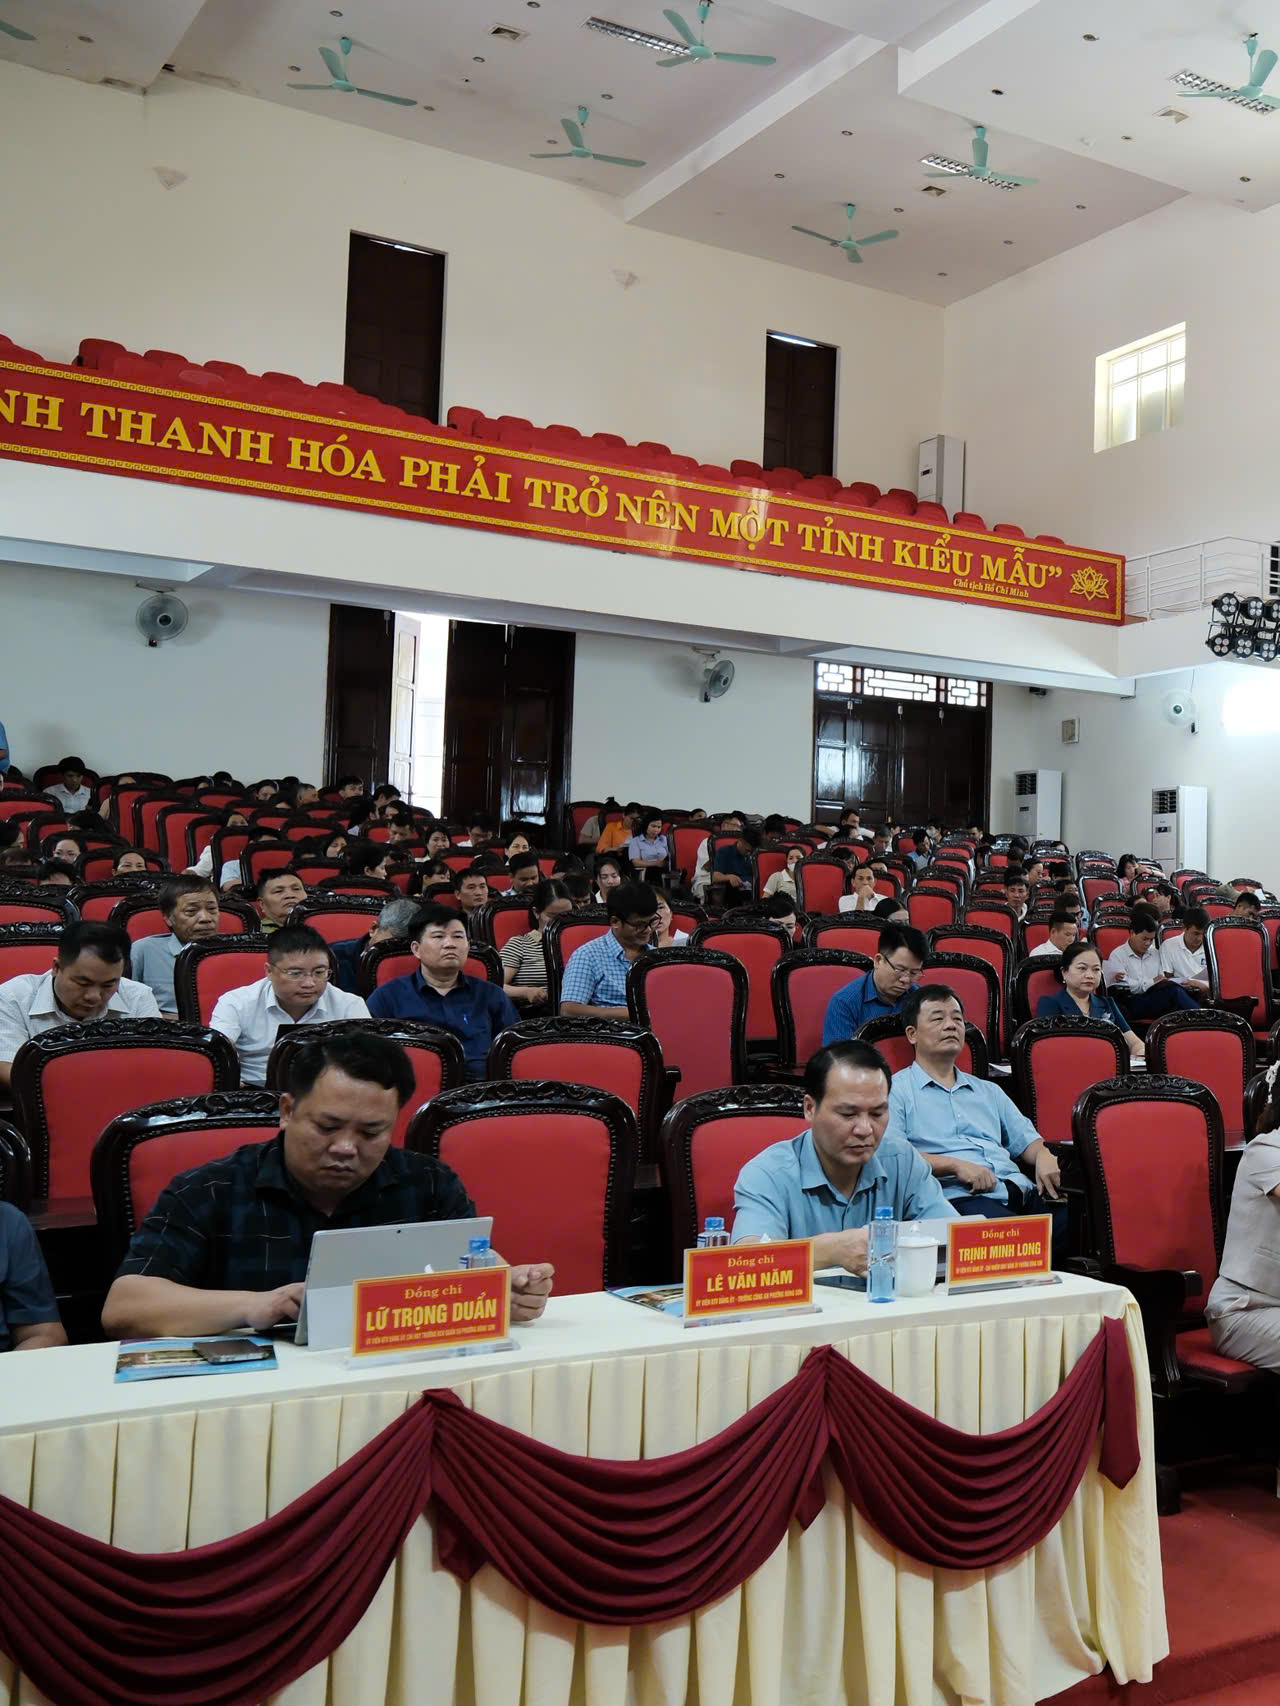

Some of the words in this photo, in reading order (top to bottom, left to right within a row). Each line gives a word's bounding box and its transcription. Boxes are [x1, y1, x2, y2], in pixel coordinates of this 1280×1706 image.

[80, 402, 273, 465] THANH
[287, 433, 386, 483] HÓA
[399, 455, 513, 504] PHẢI
[523, 474, 609, 518] TRỞ
[615, 488, 700, 533] NÊN
[708, 493, 790, 552] MỘT
[797, 516, 885, 563] TỈNH
[891, 533, 974, 577] KIỂU
[1009, 587, 1029, 598] Minh
[982, 1229, 1005, 1240] Đồng
[727, 1256, 756, 1268] Đồng
[757, 1254, 776, 1264] chí
[958, 1246, 987, 1264] TRỊNH
[989, 1244, 1015, 1259] MINH
[1017, 1241, 1041, 1257] LONG
[707, 1273, 724, 1293] LÊ
[728, 1272, 756, 1290] VĂN
[760, 1268, 793, 1287] NĂM
[404, 1286, 439, 1300] Đồng
[442, 1284, 462, 1296] chí
[392, 1303, 448, 1331] TRỌNG
[452, 1291, 497, 1322] DUẨN
